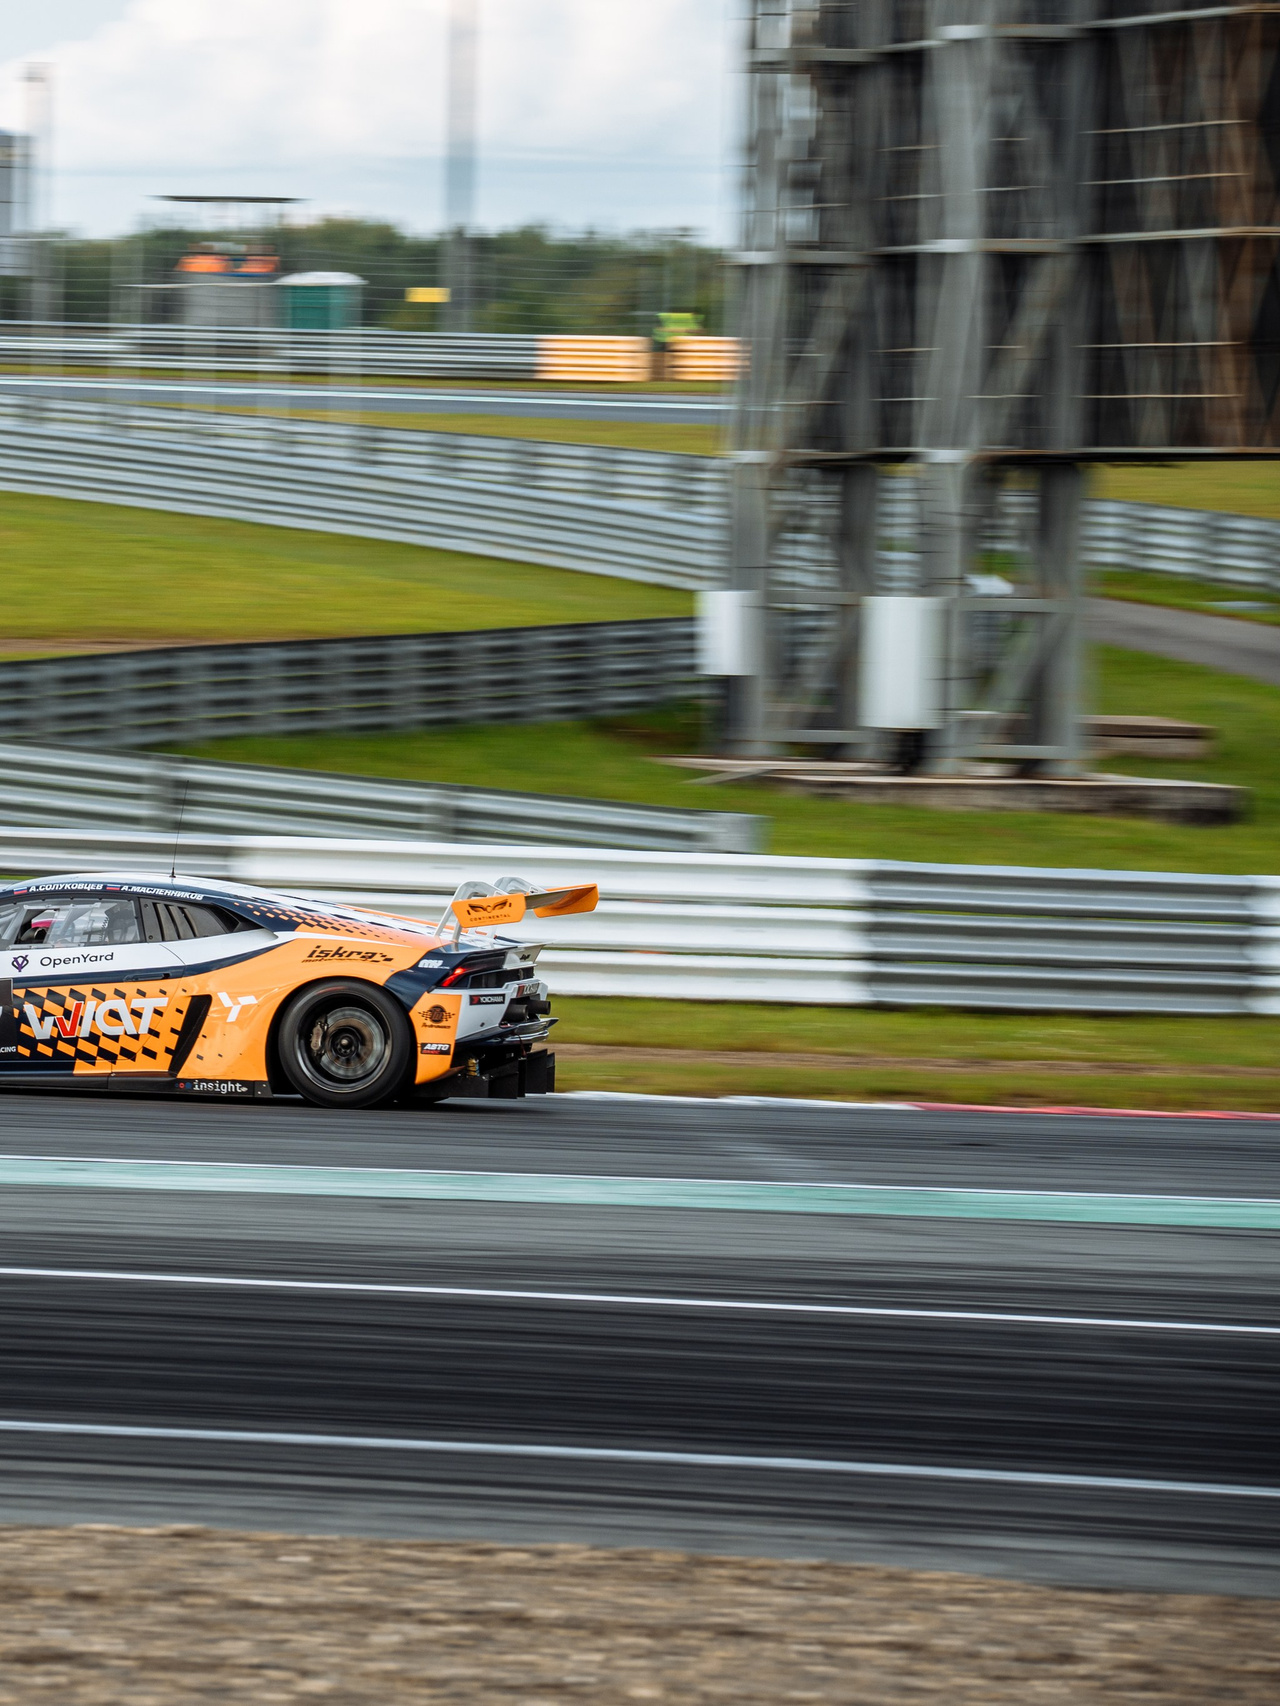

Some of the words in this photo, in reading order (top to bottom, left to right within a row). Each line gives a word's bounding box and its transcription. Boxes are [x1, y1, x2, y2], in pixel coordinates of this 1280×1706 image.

[307, 945, 378, 959] iskra
[40, 952, 114, 968] OpenYard
[193, 1079, 242, 1094] insight
